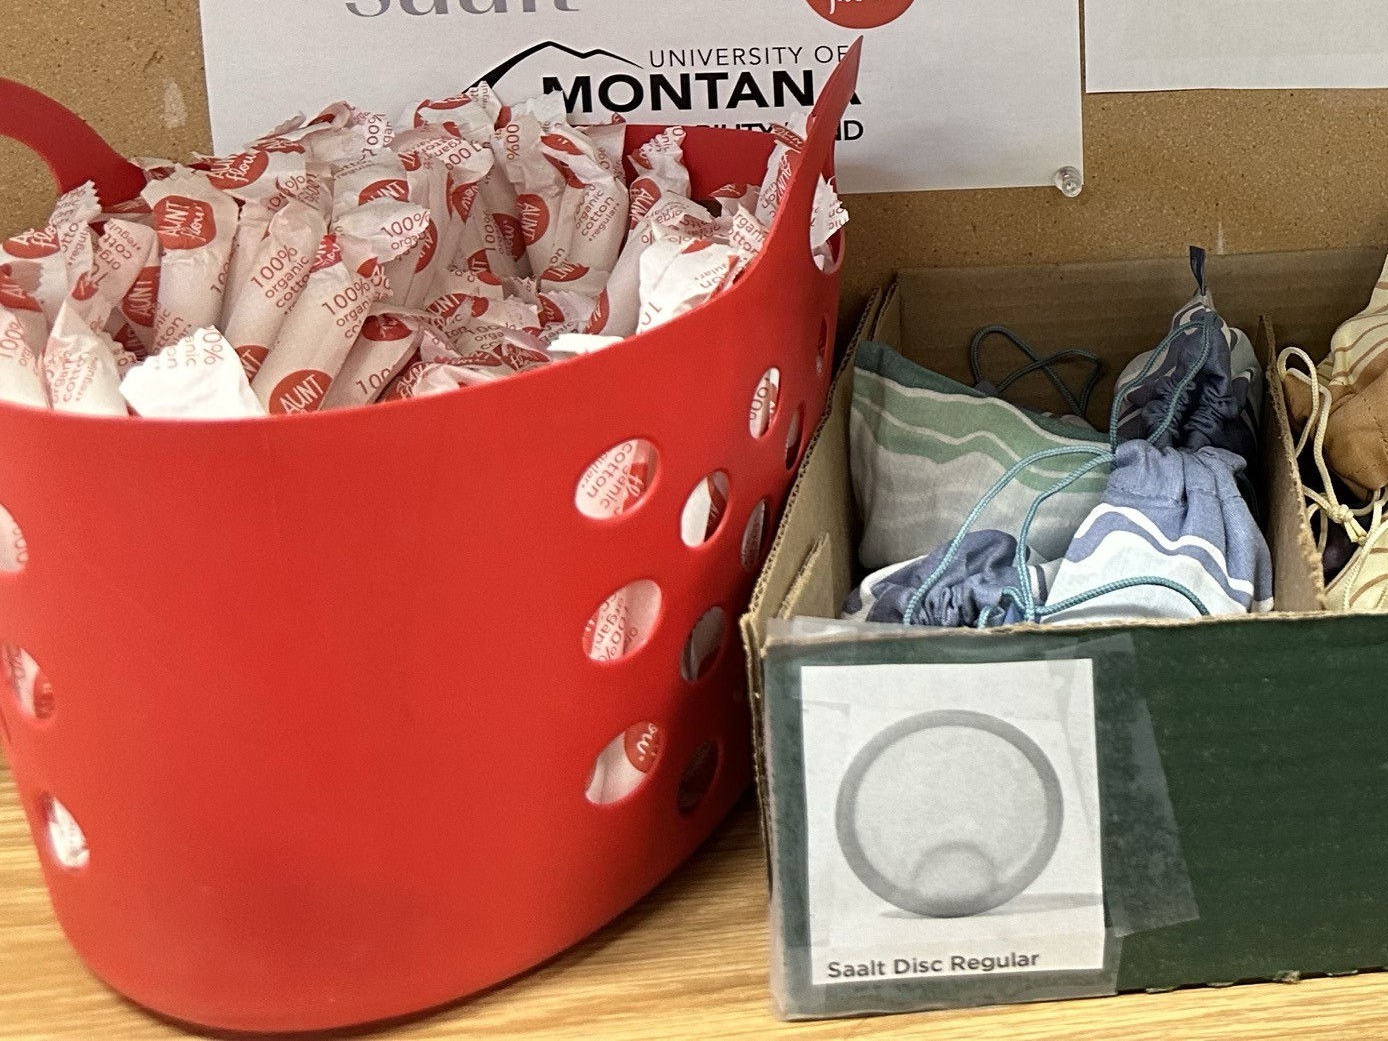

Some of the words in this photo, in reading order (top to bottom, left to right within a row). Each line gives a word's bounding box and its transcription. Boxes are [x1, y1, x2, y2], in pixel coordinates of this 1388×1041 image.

[649, 46, 803, 69] UNIVERSITY
[158, 200, 191, 238] AUNT
[581, 195, 615, 237] cotton
[250, 244, 298, 289] 100%
[264, 255, 310, 300] organic
[275, 273, 311, 309] cotto
[321, 277, 371, 316] 100%
[279, 373, 324, 414] AUNT
[586, 442, 633, 498] cotton
[828, 960, 885, 978] Saalt
[894, 958, 942, 974] Disc
[951, 953, 1039, 971] Regular
